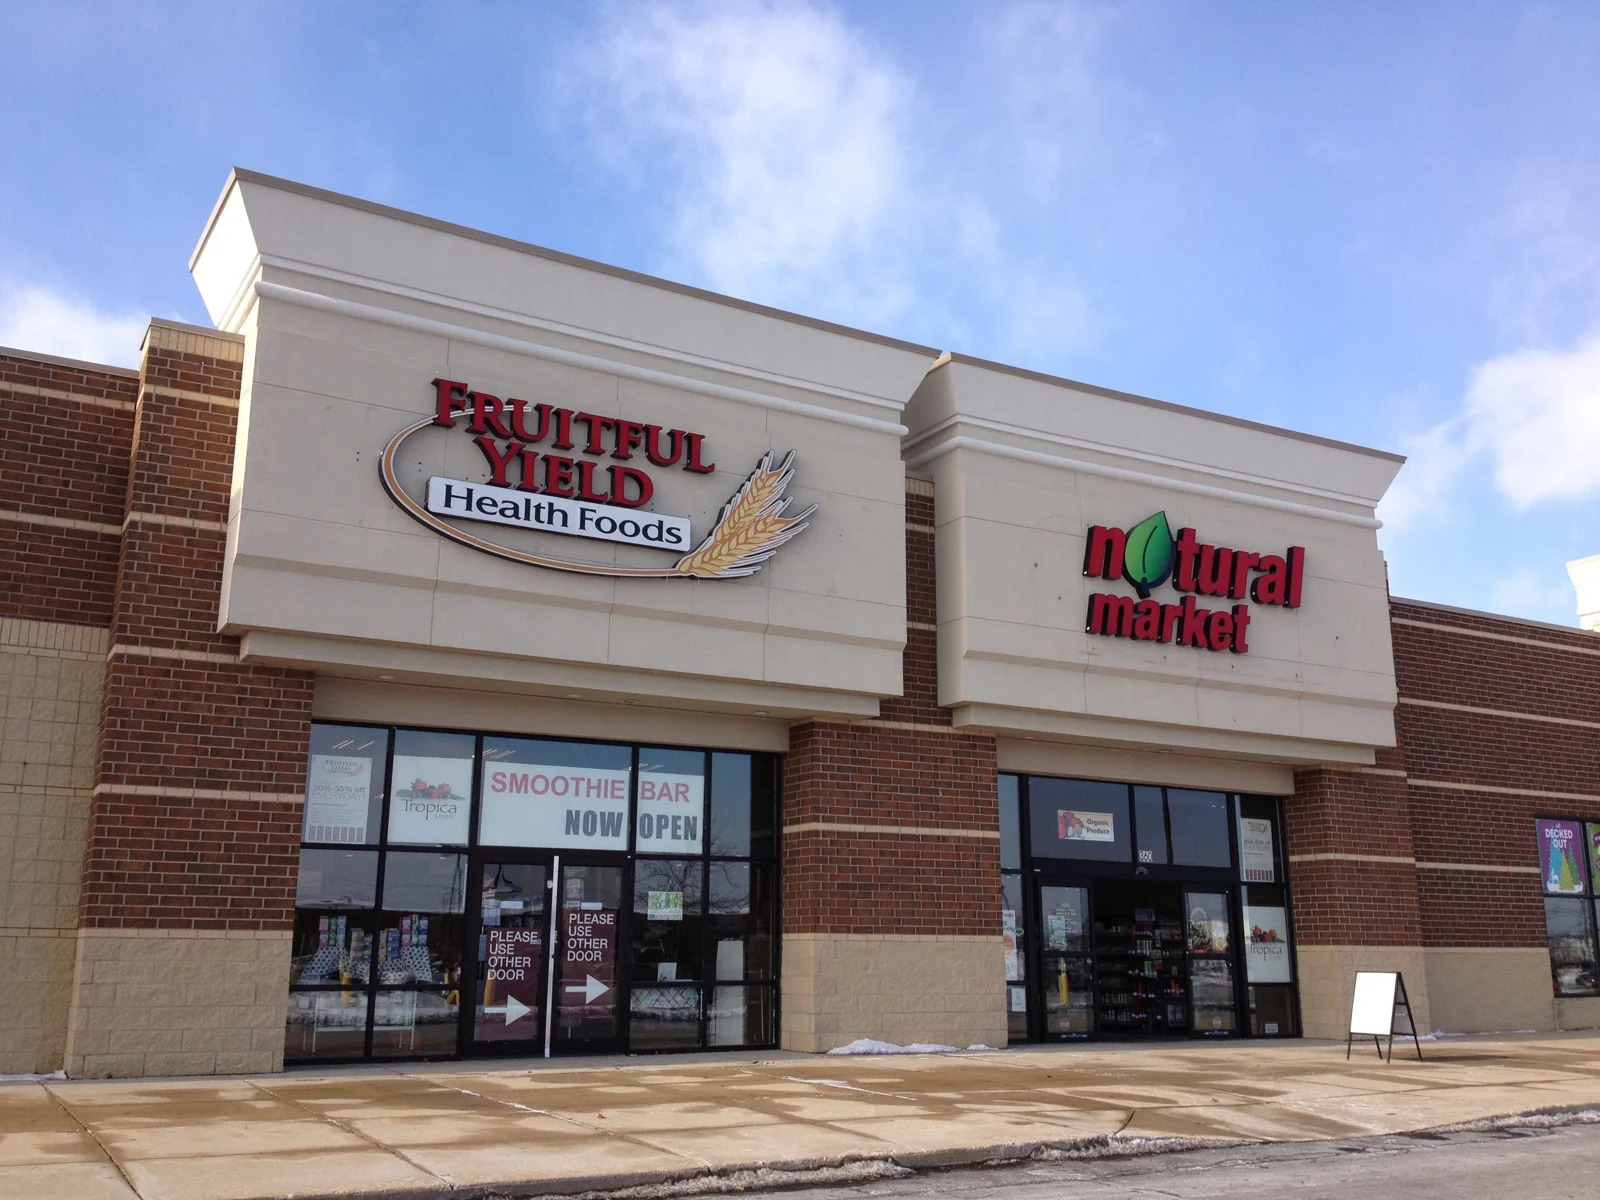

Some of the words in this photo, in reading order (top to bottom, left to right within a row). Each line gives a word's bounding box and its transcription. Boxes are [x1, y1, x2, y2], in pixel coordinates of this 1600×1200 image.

[431, 377, 715, 474] FRUITFUL
[472, 436, 653, 508] YIELD
[444, 484, 569, 528] Health
[578, 507, 683, 545] Foods
[1082, 511, 1305, 609] ntural
[1085, 593, 1251, 653] market
[491, 771, 625, 799] SMOOTHIE
[641, 780, 690, 802] BAR
[401, 799, 457, 820] Tropica
[565, 809, 623, 837] NOW
[639, 813, 698, 841] OPEN
[1086, 818, 1109, 826] Organic
[1545, 828, 1573, 839] DECKED
[1553, 838, 1568, 848] OUT
[1139, 850, 1153, 862] 360
[569, 913, 614, 925] PLEASE
[490, 931, 538, 942] PLEASE
[568, 926, 592, 937] USE
[489, 944, 514, 955] USE
[567, 938, 608, 949] OTHER
[567, 950, 602, 962] DOOR
[1250, 943, 1283, 961] Tropica
[488, 956, 531, 968] OTHER
[487, 969, 525, 981] DOOR
